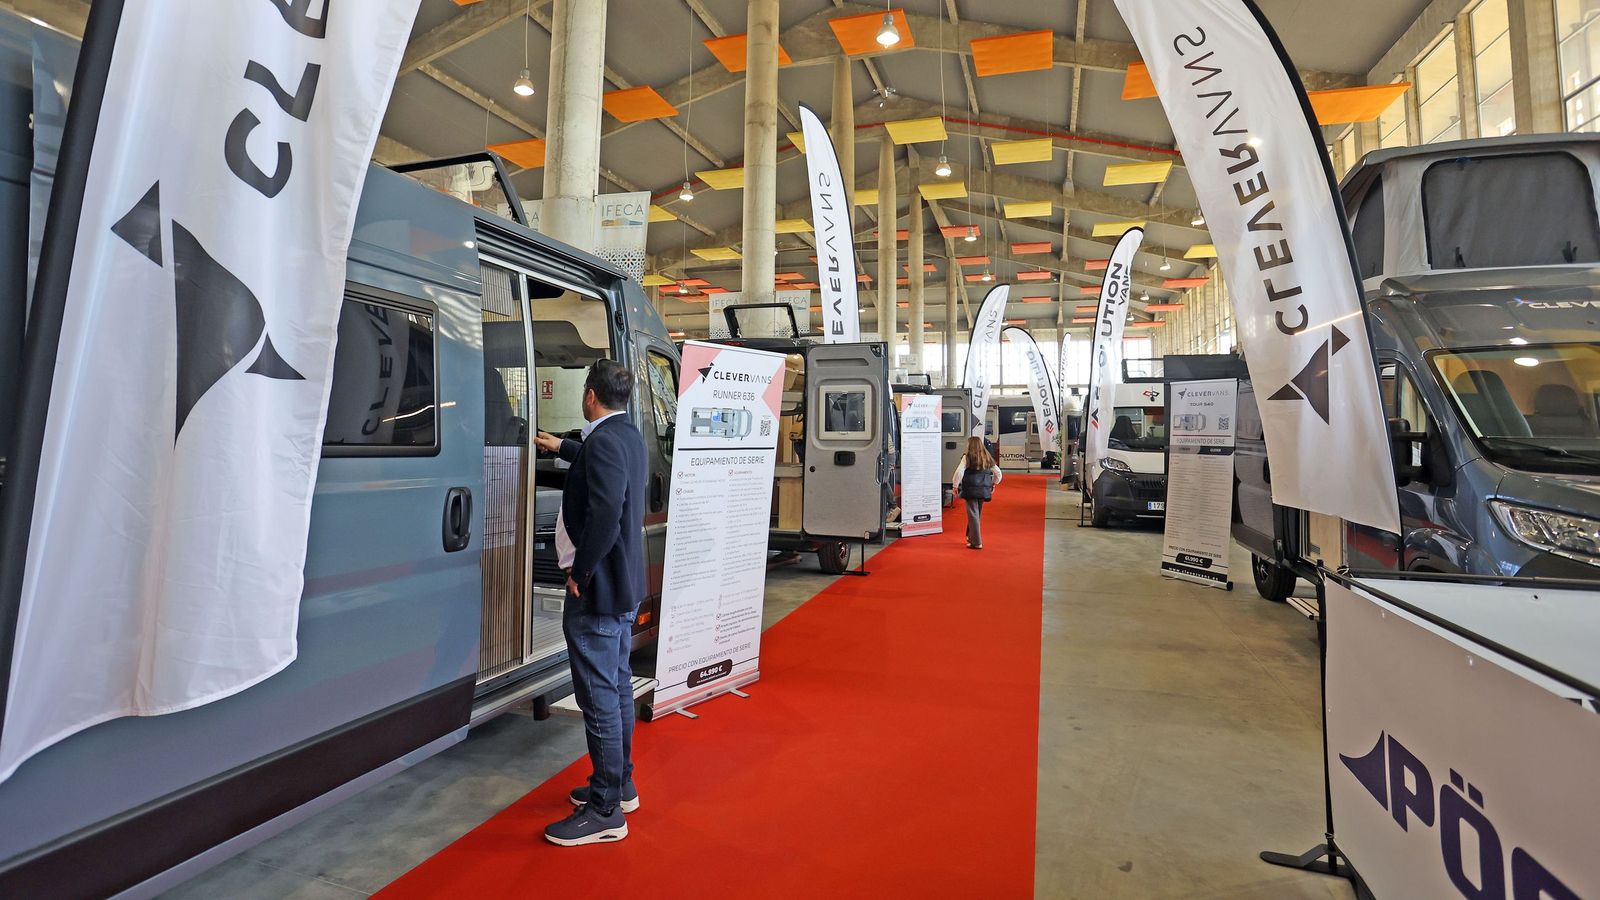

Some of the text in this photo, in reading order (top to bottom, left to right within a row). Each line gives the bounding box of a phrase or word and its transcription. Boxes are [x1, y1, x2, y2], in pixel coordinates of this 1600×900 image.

[601, 204, 644, 217] IFECA
[713, 371, 772, 385] CLEVERVANS
[713, 390, 755, 401] RUNNER 636
[691, 456, 764, 466] EQUIPAMIENTO DE SERIE
[668, 642, 752, 673] PRECIO CON EQUIPAMIENTO DE SERIE
[1388, 734, 1584, 900] PÖ
